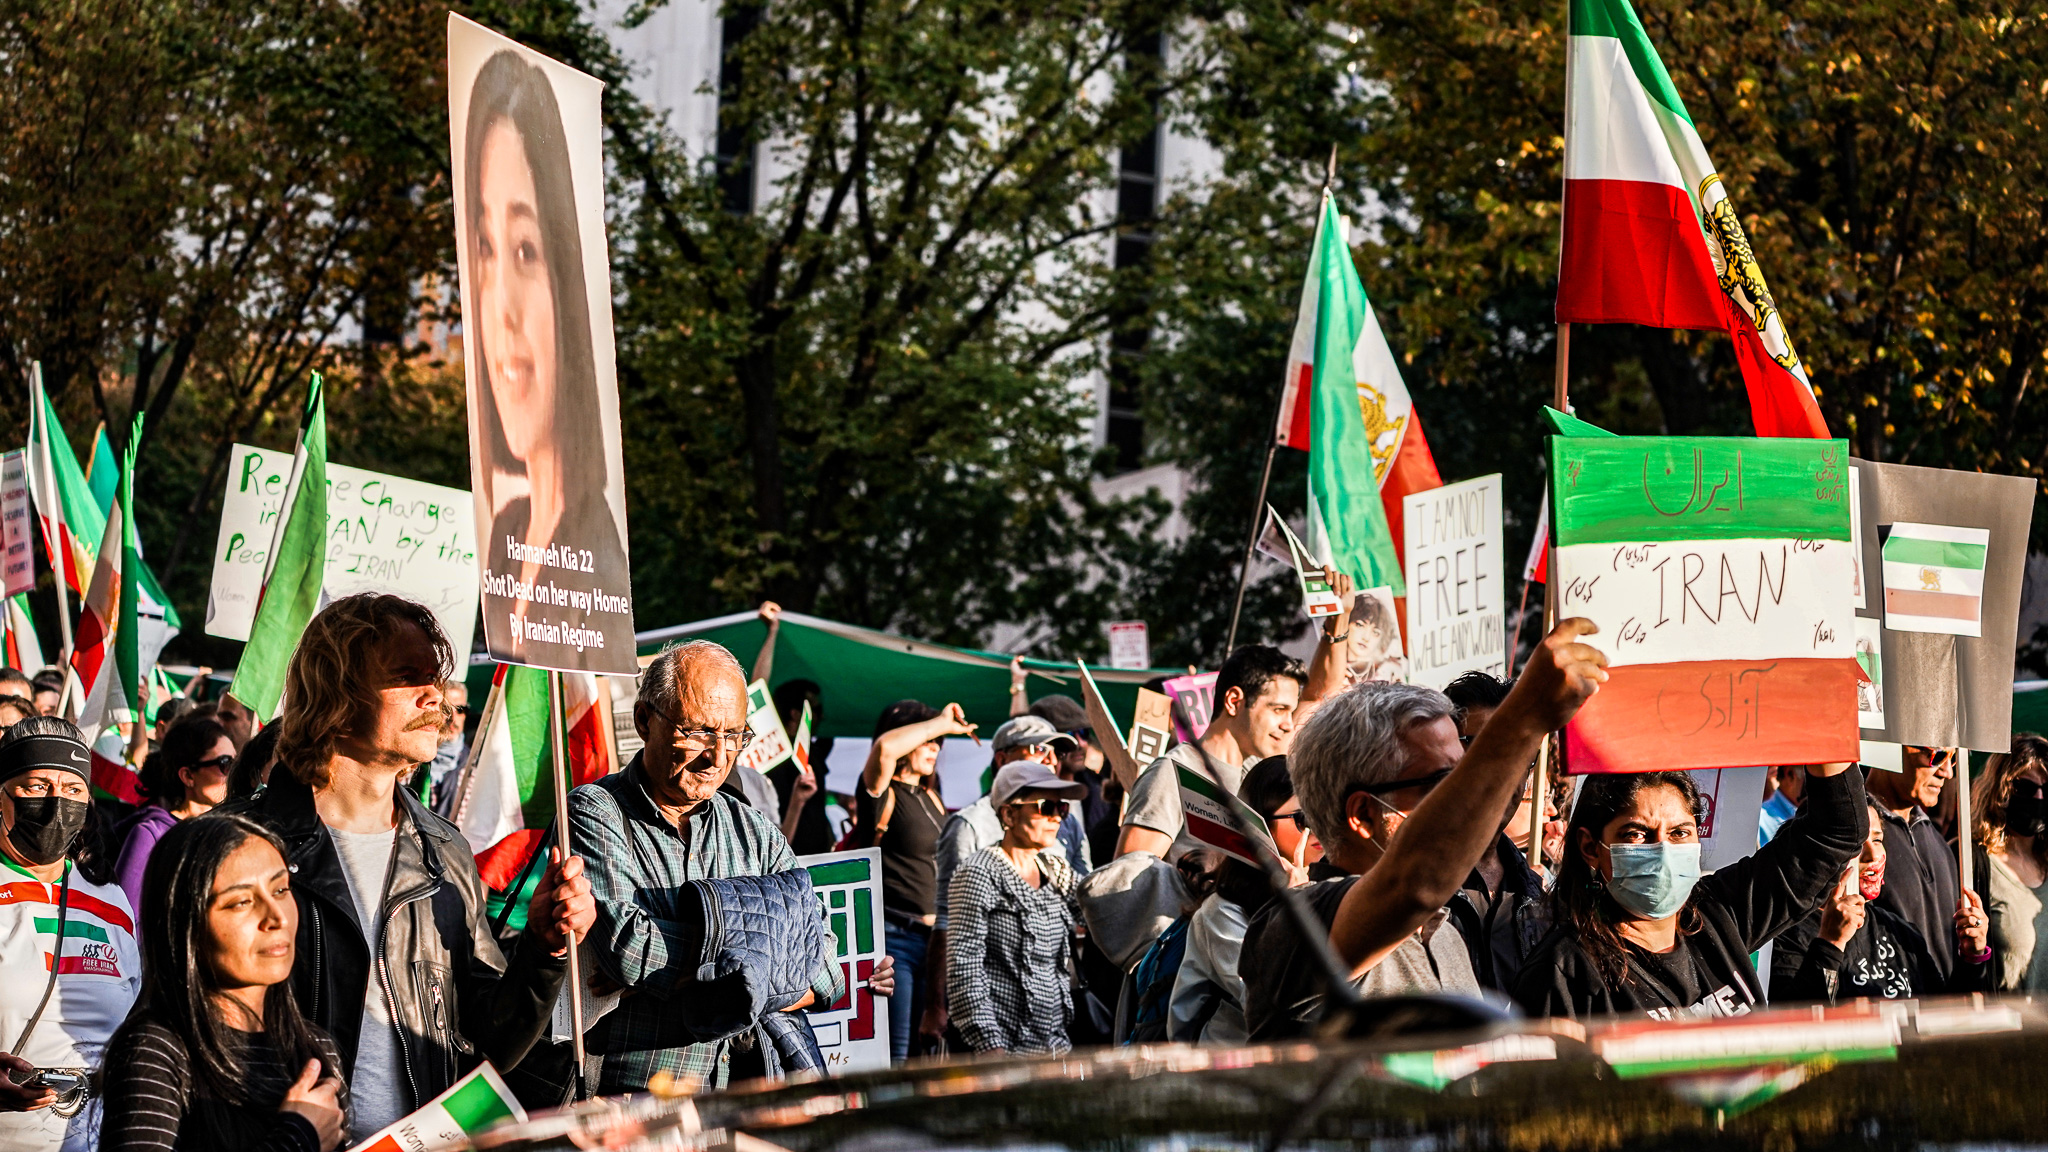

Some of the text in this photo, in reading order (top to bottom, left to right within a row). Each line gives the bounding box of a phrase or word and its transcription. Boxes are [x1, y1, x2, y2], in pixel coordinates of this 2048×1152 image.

[239, 452, 456, 534] Ree Change
[1643, 448, 1743, 516] ایران
[325, 513, 381, 545] AN
[396, 525, 425, 564] by
[437, 532, 474, 565] the
[1415, 486, 1489, 549] I AM NOT
[346, 554, 403, 581] IRAN
[507, 535, 595, 573] Hannaneh Kia 22
[483, 569, 507, 597] Shot
[507, 574, 534, 602] Dead
[535, 584, 550, 605] on
[550, 580, 569, 607] her
[569, 589, 592, 616] way
[593, 588, 629, 614] Home
[1417, 542, 1487, 626] FREE
[1653, 545, 1787, 628] IRAN
[509, 613, 604, 652] By Iranian Regime
[1184, 800, 1222, 823] Woman,
[82, 958, 114, 971] FREE IRAN
[1876, 936, 1895, 960] زن
[1853, 958, 1895, 986] زندگی
